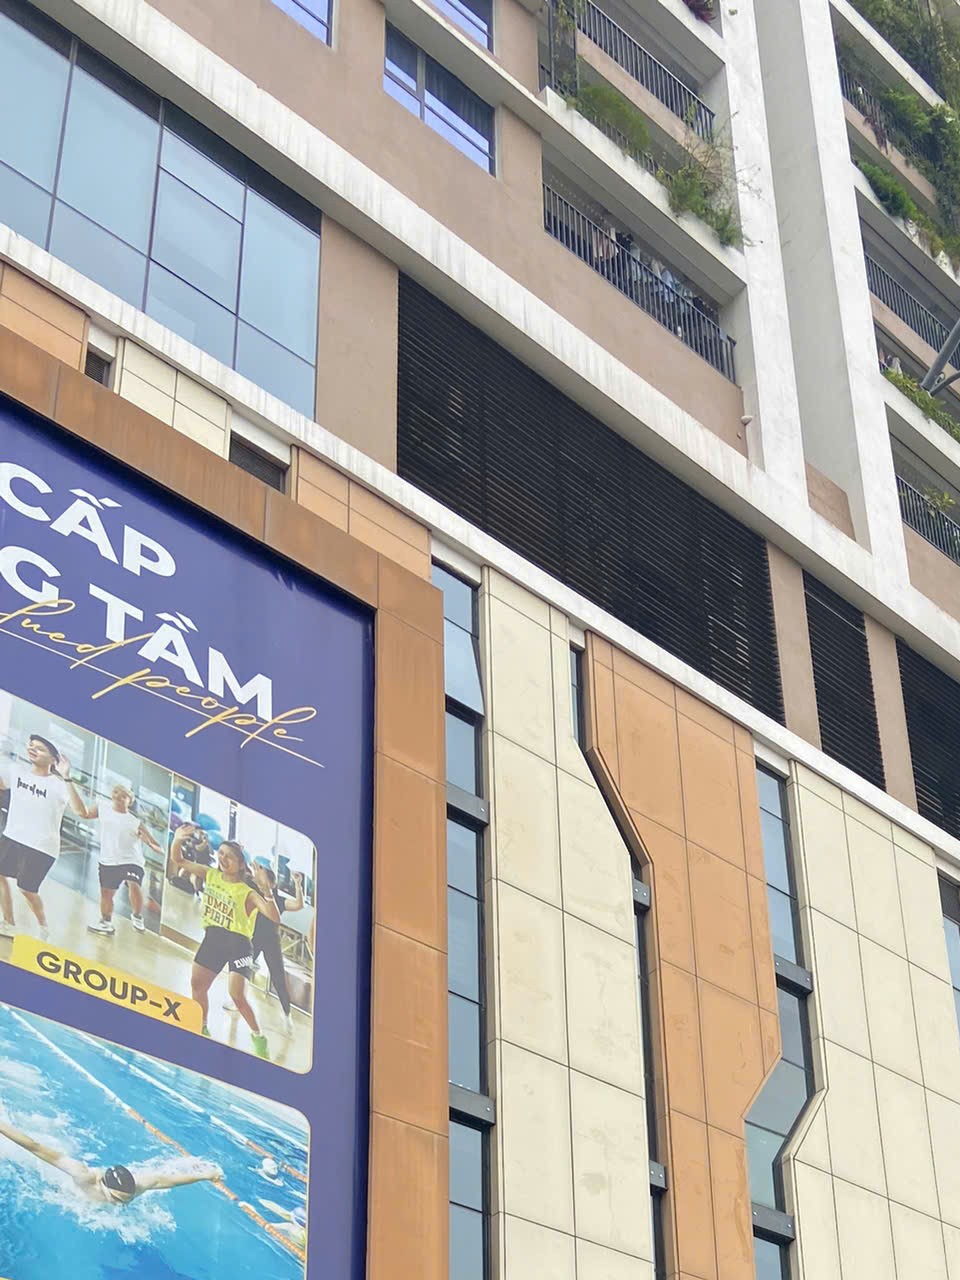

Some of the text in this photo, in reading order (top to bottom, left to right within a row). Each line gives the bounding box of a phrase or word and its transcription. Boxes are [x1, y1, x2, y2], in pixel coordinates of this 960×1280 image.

[0, 461, 177, 577] CẤP
[91, 668, 318, 749] people
[36, 950, 182, 1022] GROUP-X
